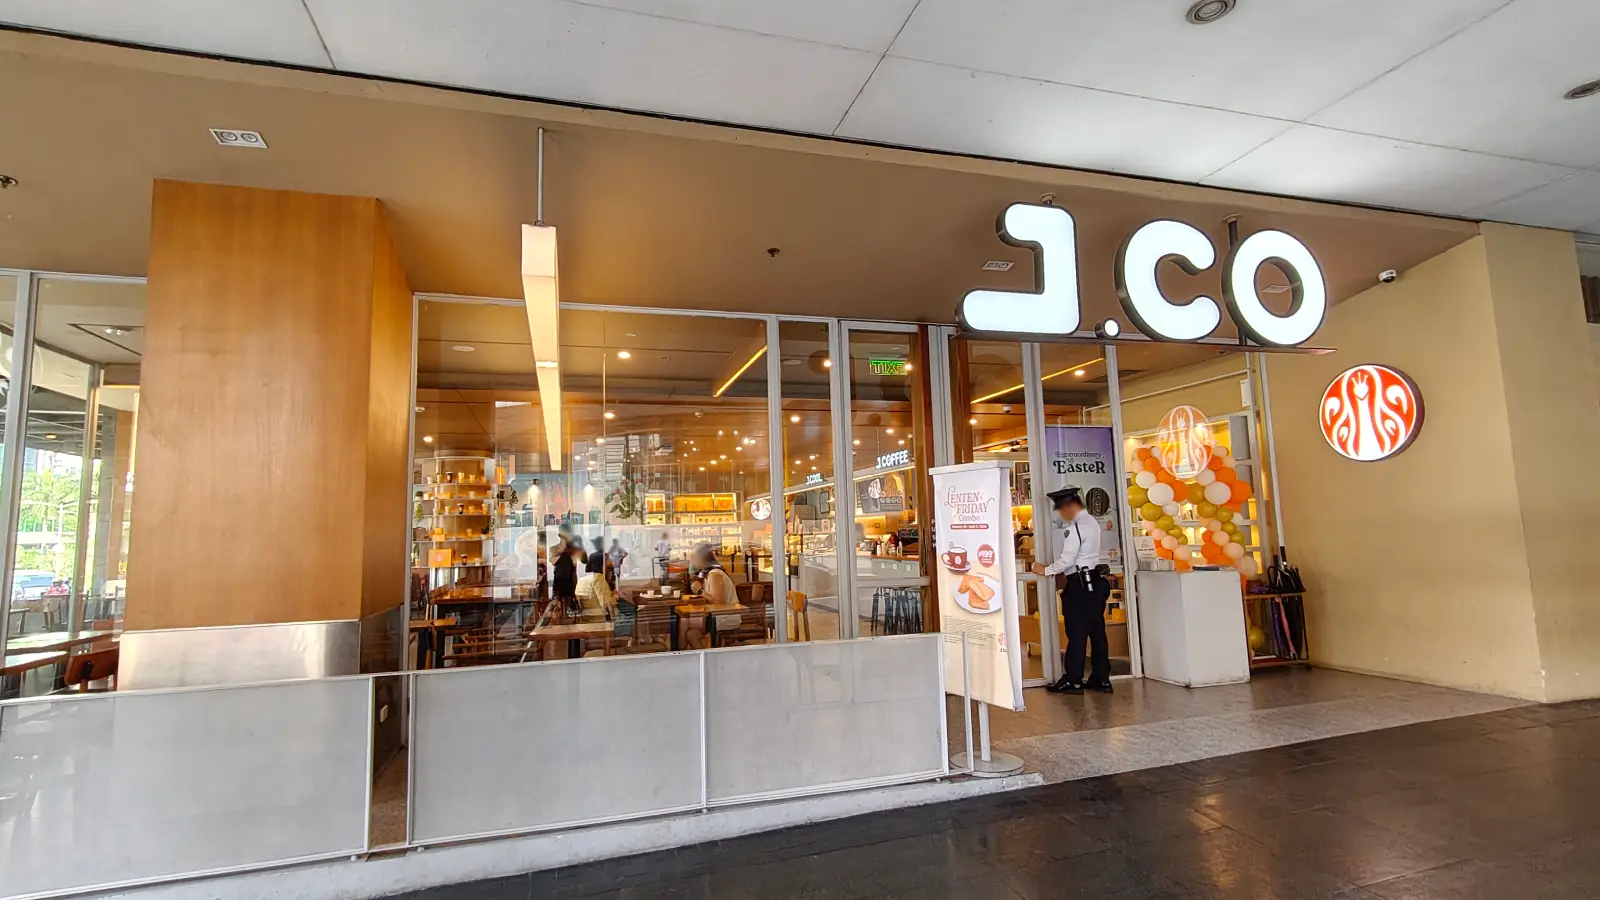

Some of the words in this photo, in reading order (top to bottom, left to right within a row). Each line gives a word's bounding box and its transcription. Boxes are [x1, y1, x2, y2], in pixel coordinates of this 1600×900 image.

[957, 201, 1327, 347] J.CO
[944, 485, 980, 508] LENTEN
[957, 497, 996, 514] FRIDAY
[958, 514, 981, 522] Combo
